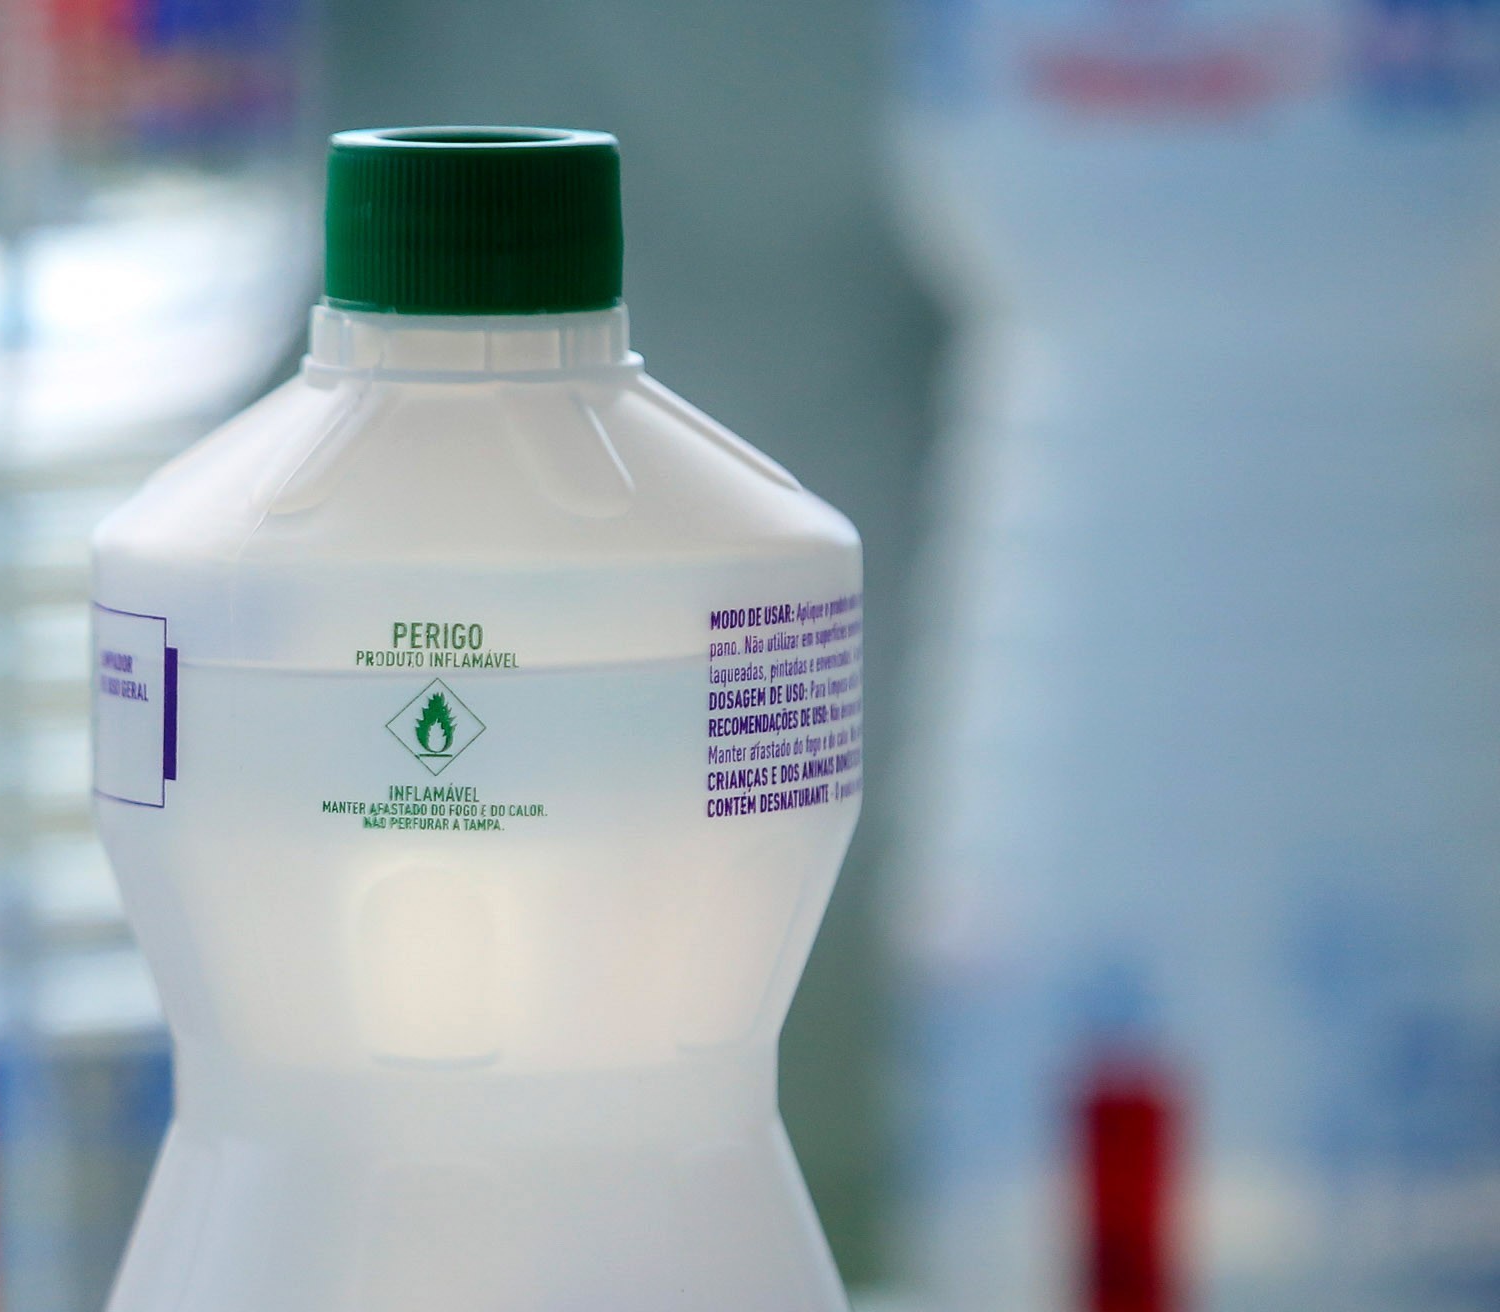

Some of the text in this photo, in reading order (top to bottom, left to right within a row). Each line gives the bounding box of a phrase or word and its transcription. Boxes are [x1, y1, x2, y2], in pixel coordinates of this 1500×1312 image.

[710, 609, 746, 630] MODO
[748, 606, 762, 627] DE
[764, 604, 795, 625] USAR:
[393, 622, 483, 650] PERIGO
[710, 641, 741, 661] pano.
[745, 635, 764, 654] Não
[767, 632, 799, 652] utilizar
[356, 649, 519, 668] PRODUTO INFLAMÁVEL
[709, 661, 767, 687] laqueadas,
[770, 658, 807, 683] pintadas
[121, 680, 149, 702] GERAL
[709, 687, 766, 711] DOSAGEM
[770, 686, 783, 706] DE
[786, 682, 808, 703] USO:
[708, 708, 798, 737] RECOMENDAÇÕES
[801, 709, 811, 727] DE
[708, 745, 746, 764] Manter
[750, 741, 790, 761] afastado
[793, 738, 803, 755] do
[707, 767, 768, 792] CRIANÇAS
[771, 766, 777, 784] E
[781, 763, 800, 784] DOS
[802, 756, 835, 780] ANIMAIS
[389, 783, 480, 802] INFLAMÁVEL
[707, 792, 757, 817] CONTÉM
[760, 784, 829, 812] DESNATURANTE
[322, 800, 366, 815] MANTER
[369, 802, 428, 816] AFASTADO
[431, 803, 446, 816] DO
[449, 804, 478, 817] FOGO
[490, 804, 506, 817] DO
[509, 804, 548, 817] CALOR.
[363, 813, 505, 831] NÃO PERFURAR A TAMPA.
